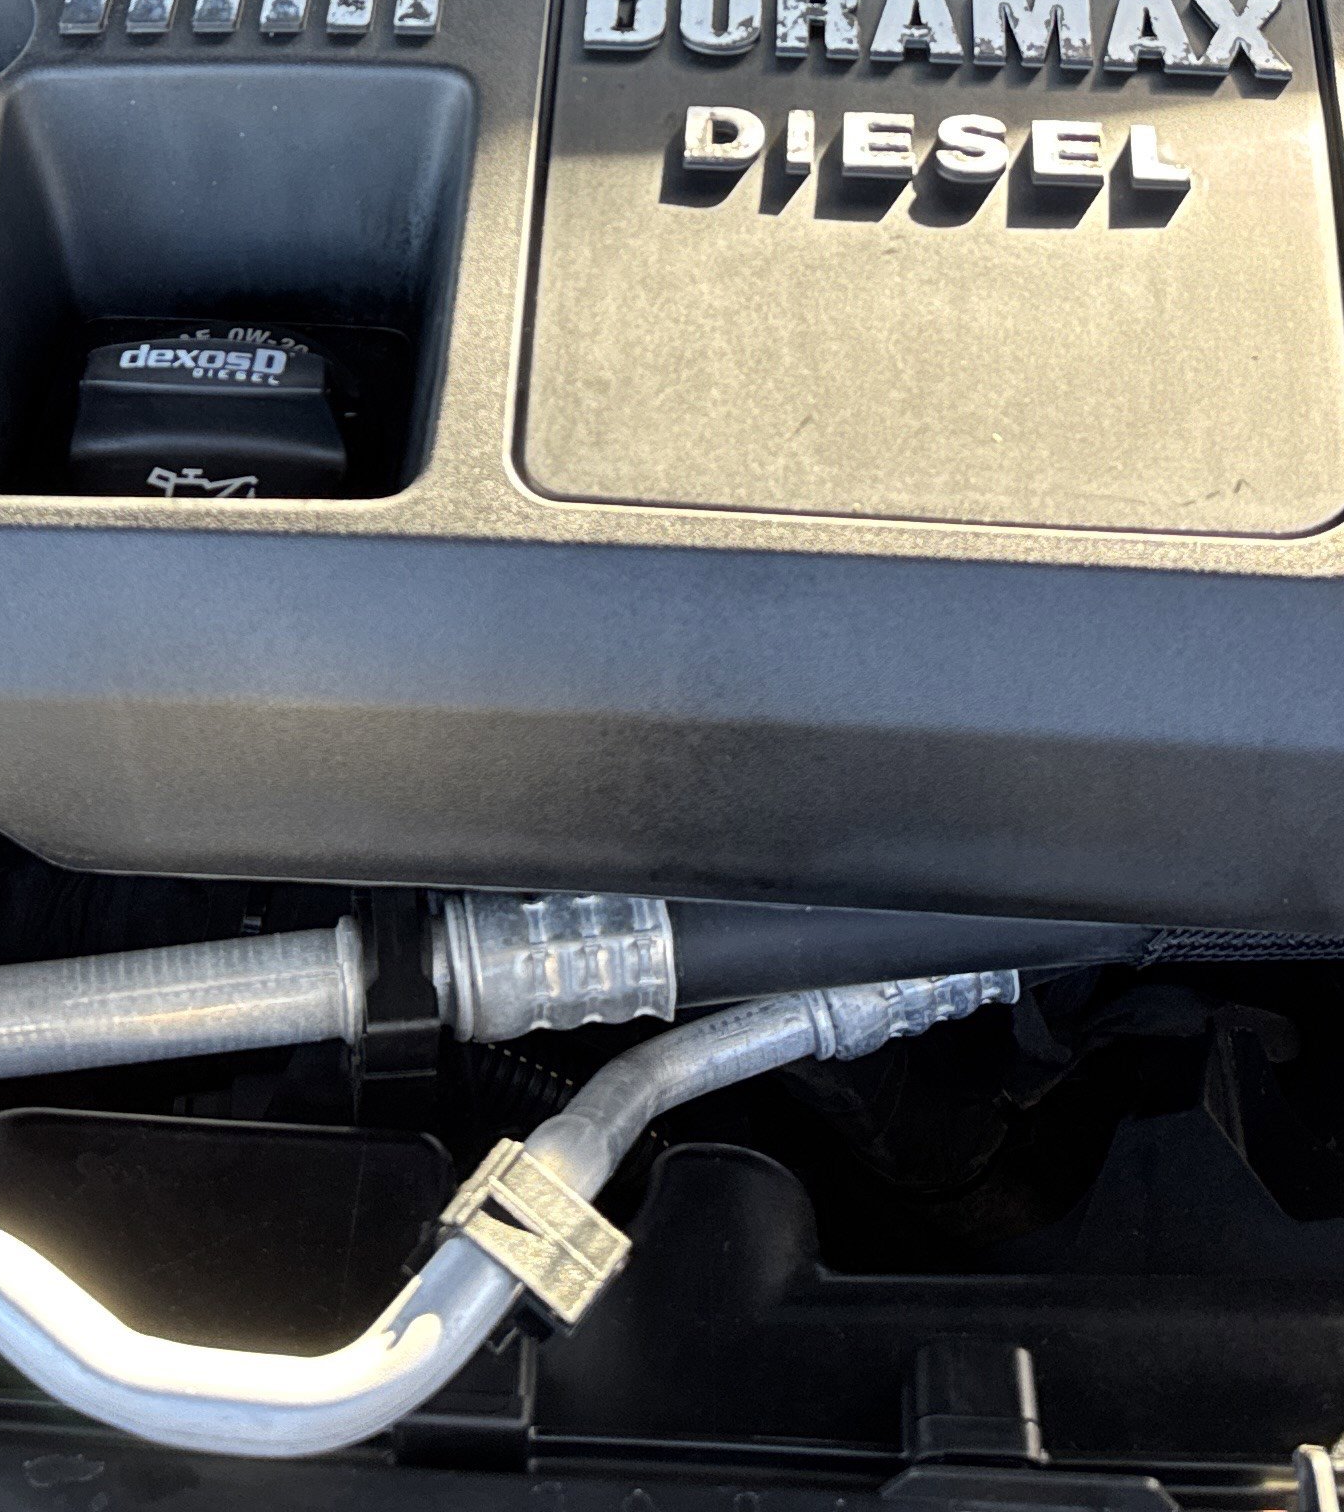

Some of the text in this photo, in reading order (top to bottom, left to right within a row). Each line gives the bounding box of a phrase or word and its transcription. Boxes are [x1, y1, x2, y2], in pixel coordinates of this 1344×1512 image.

[682, 105, 1192, 189] DIESEL
[119, 344, 288, 374] dexosD
[192, 368, 280, 385] DIESEL
